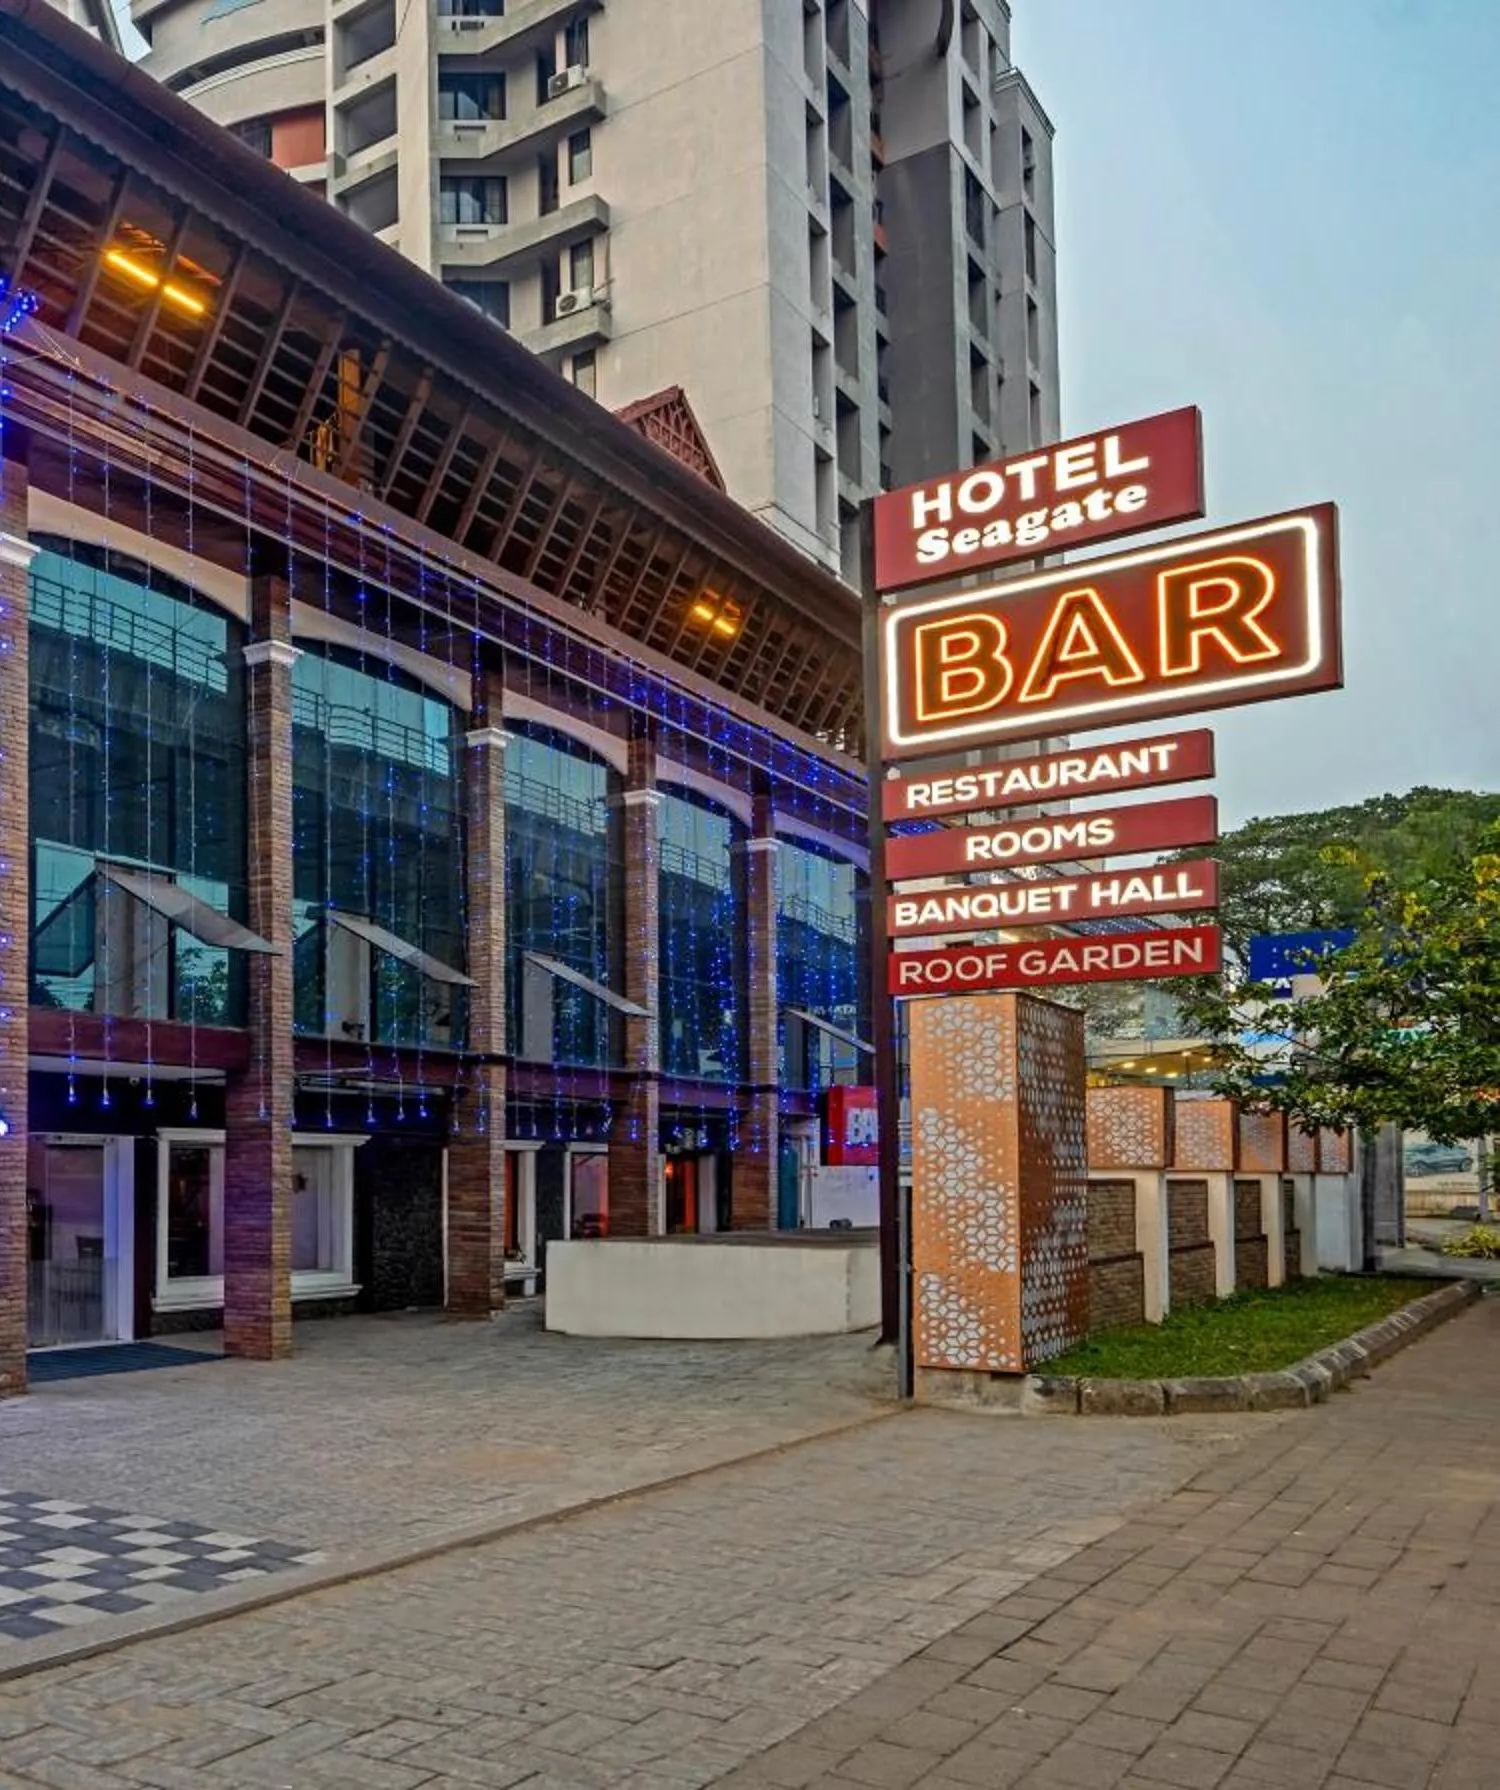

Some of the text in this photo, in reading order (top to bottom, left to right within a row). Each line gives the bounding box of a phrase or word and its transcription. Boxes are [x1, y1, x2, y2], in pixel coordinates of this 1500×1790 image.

[912, 435, 1149, 529] HOTEL
[916, 485, 1148, 563] Seagate
[913, 555, 1281, 722] BAR
[906, 743, 1178, 808] RESTAURANT
[966, 818, 1115, 861] ROOMS
[895, 872, 1203, 927] BANQUET HALL
[899, 937, 1203, 984] ROOF GARDEN
